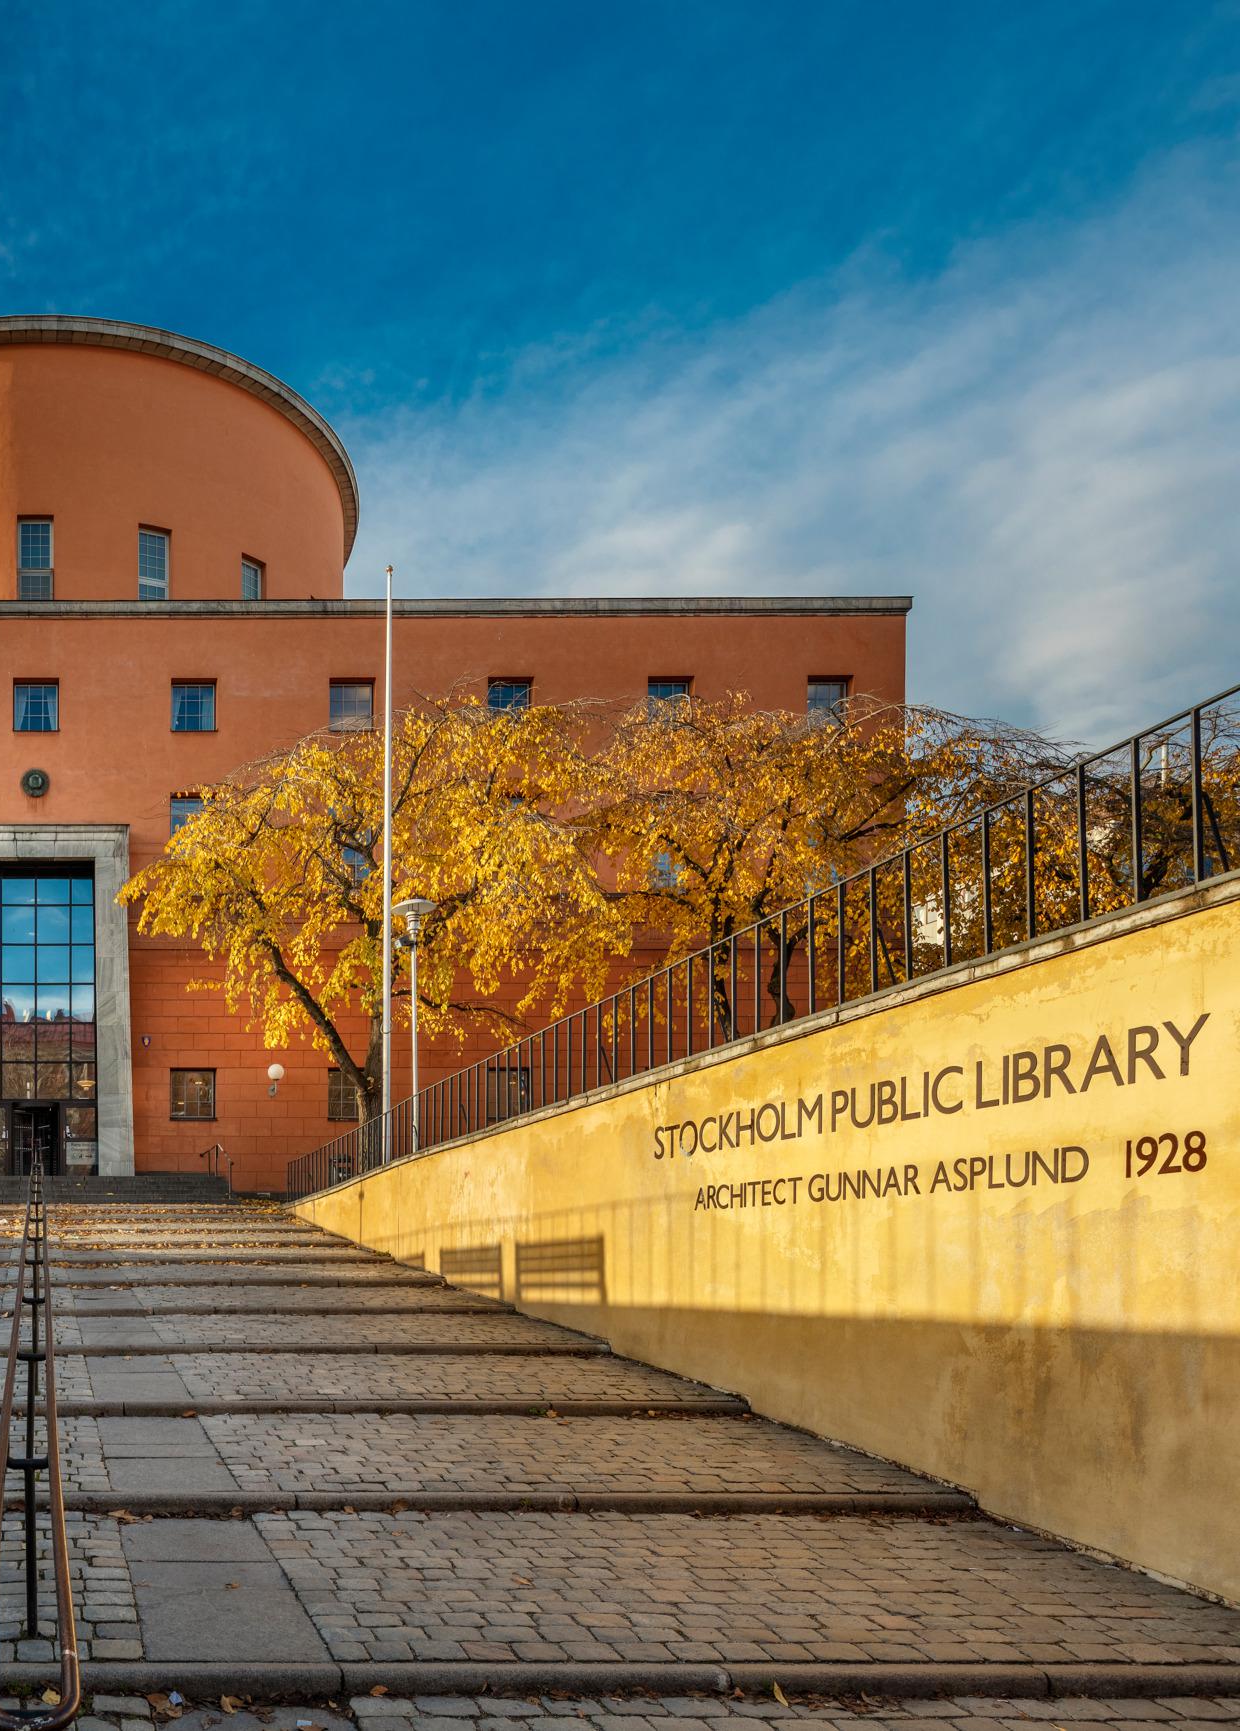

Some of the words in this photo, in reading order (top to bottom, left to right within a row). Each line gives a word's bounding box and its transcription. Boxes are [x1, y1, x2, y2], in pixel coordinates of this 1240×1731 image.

[653, 1094, 823, 1160] STOCKHOLM
[831, 1066, 964, 1132] PUBLIC
[976, 1013, 1211, 1109] LIBRARY
[694, 1176, 803, 1211] ARCHITECT
[808, 1164, 921, 1202] GUNNAR
[929, 1146, 1090, 1193] ASPLUND
[1125, 1131, 1208, 1178] 1928
